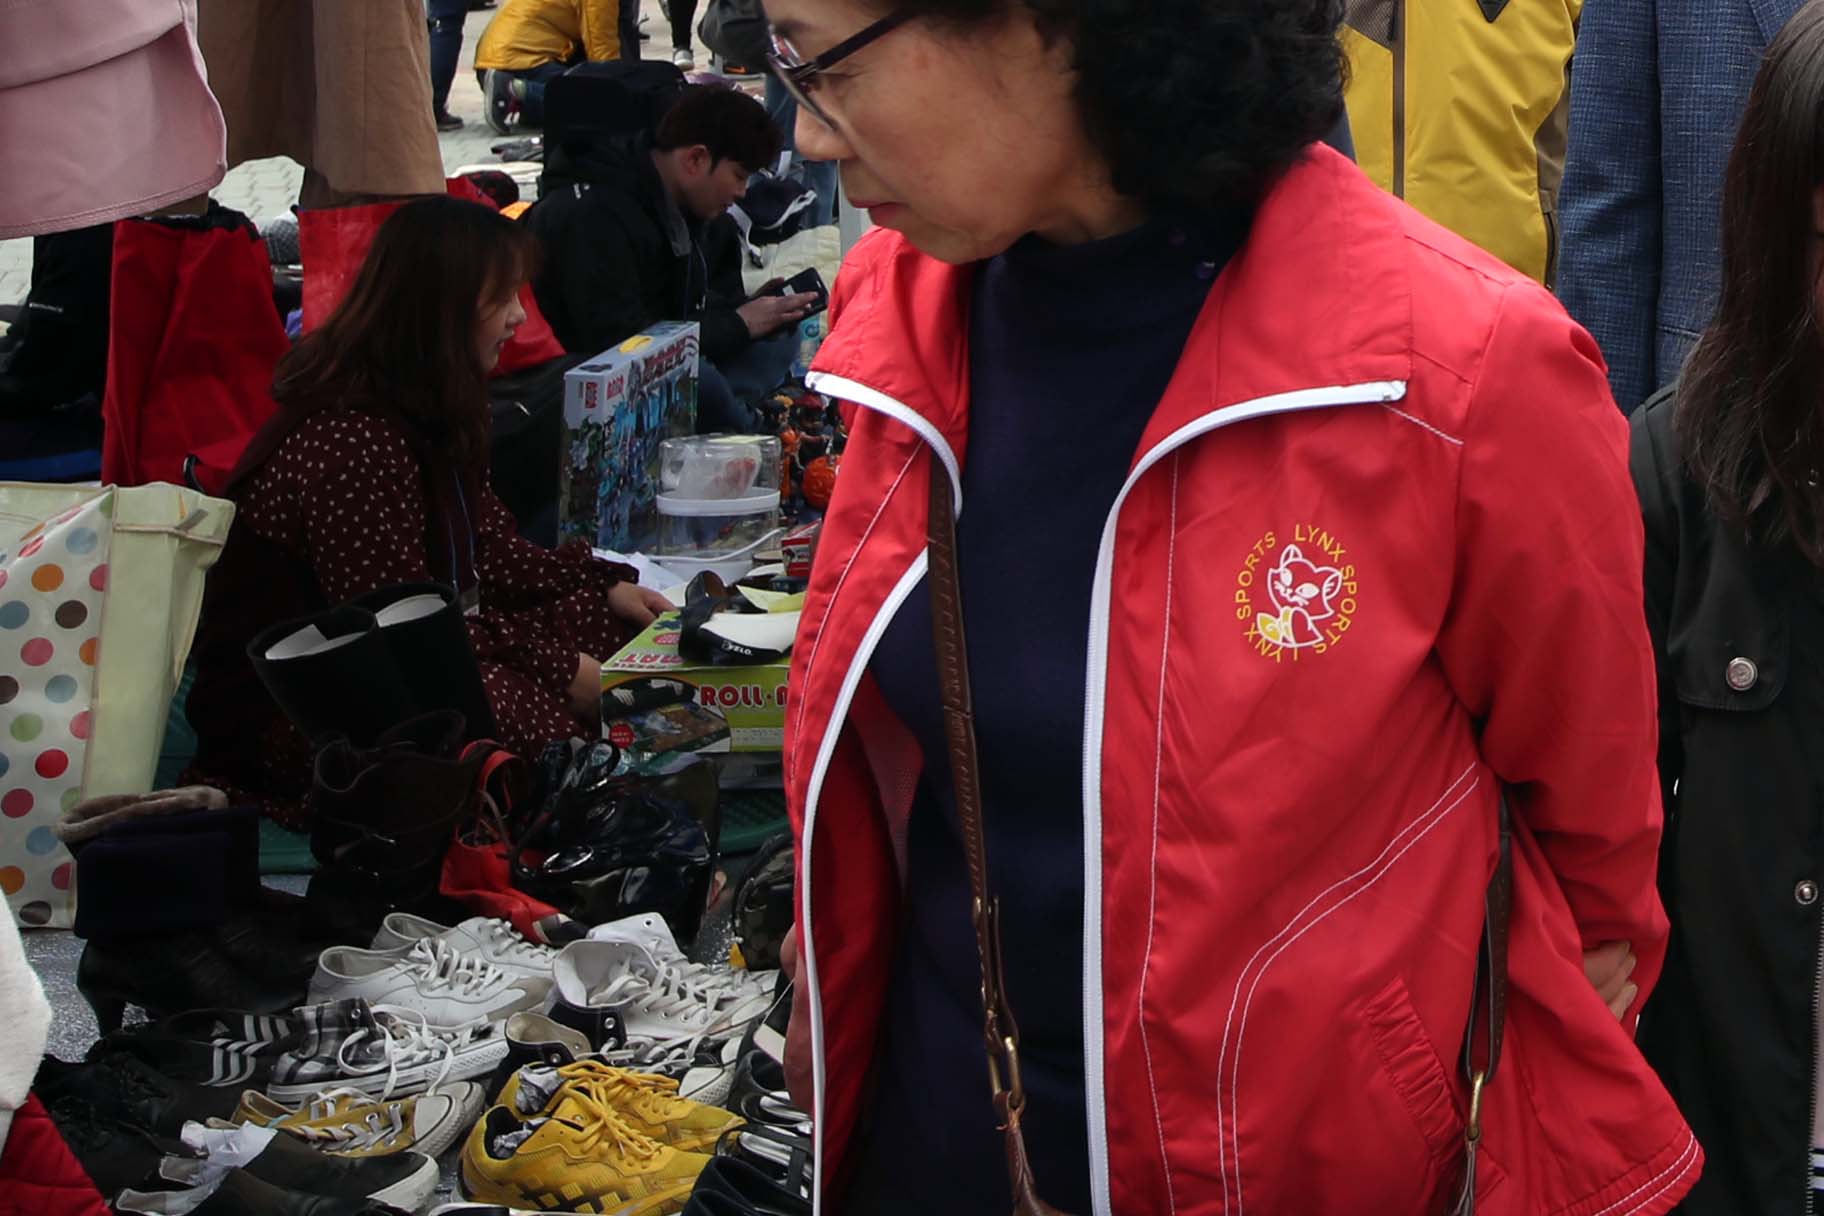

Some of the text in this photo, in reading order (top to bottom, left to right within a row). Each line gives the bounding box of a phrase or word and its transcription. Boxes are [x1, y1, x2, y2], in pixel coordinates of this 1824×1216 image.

[1235, 531, 1276, 620] SPORTS
[1295, 524, 1357, 654] LYNX SPORTS
